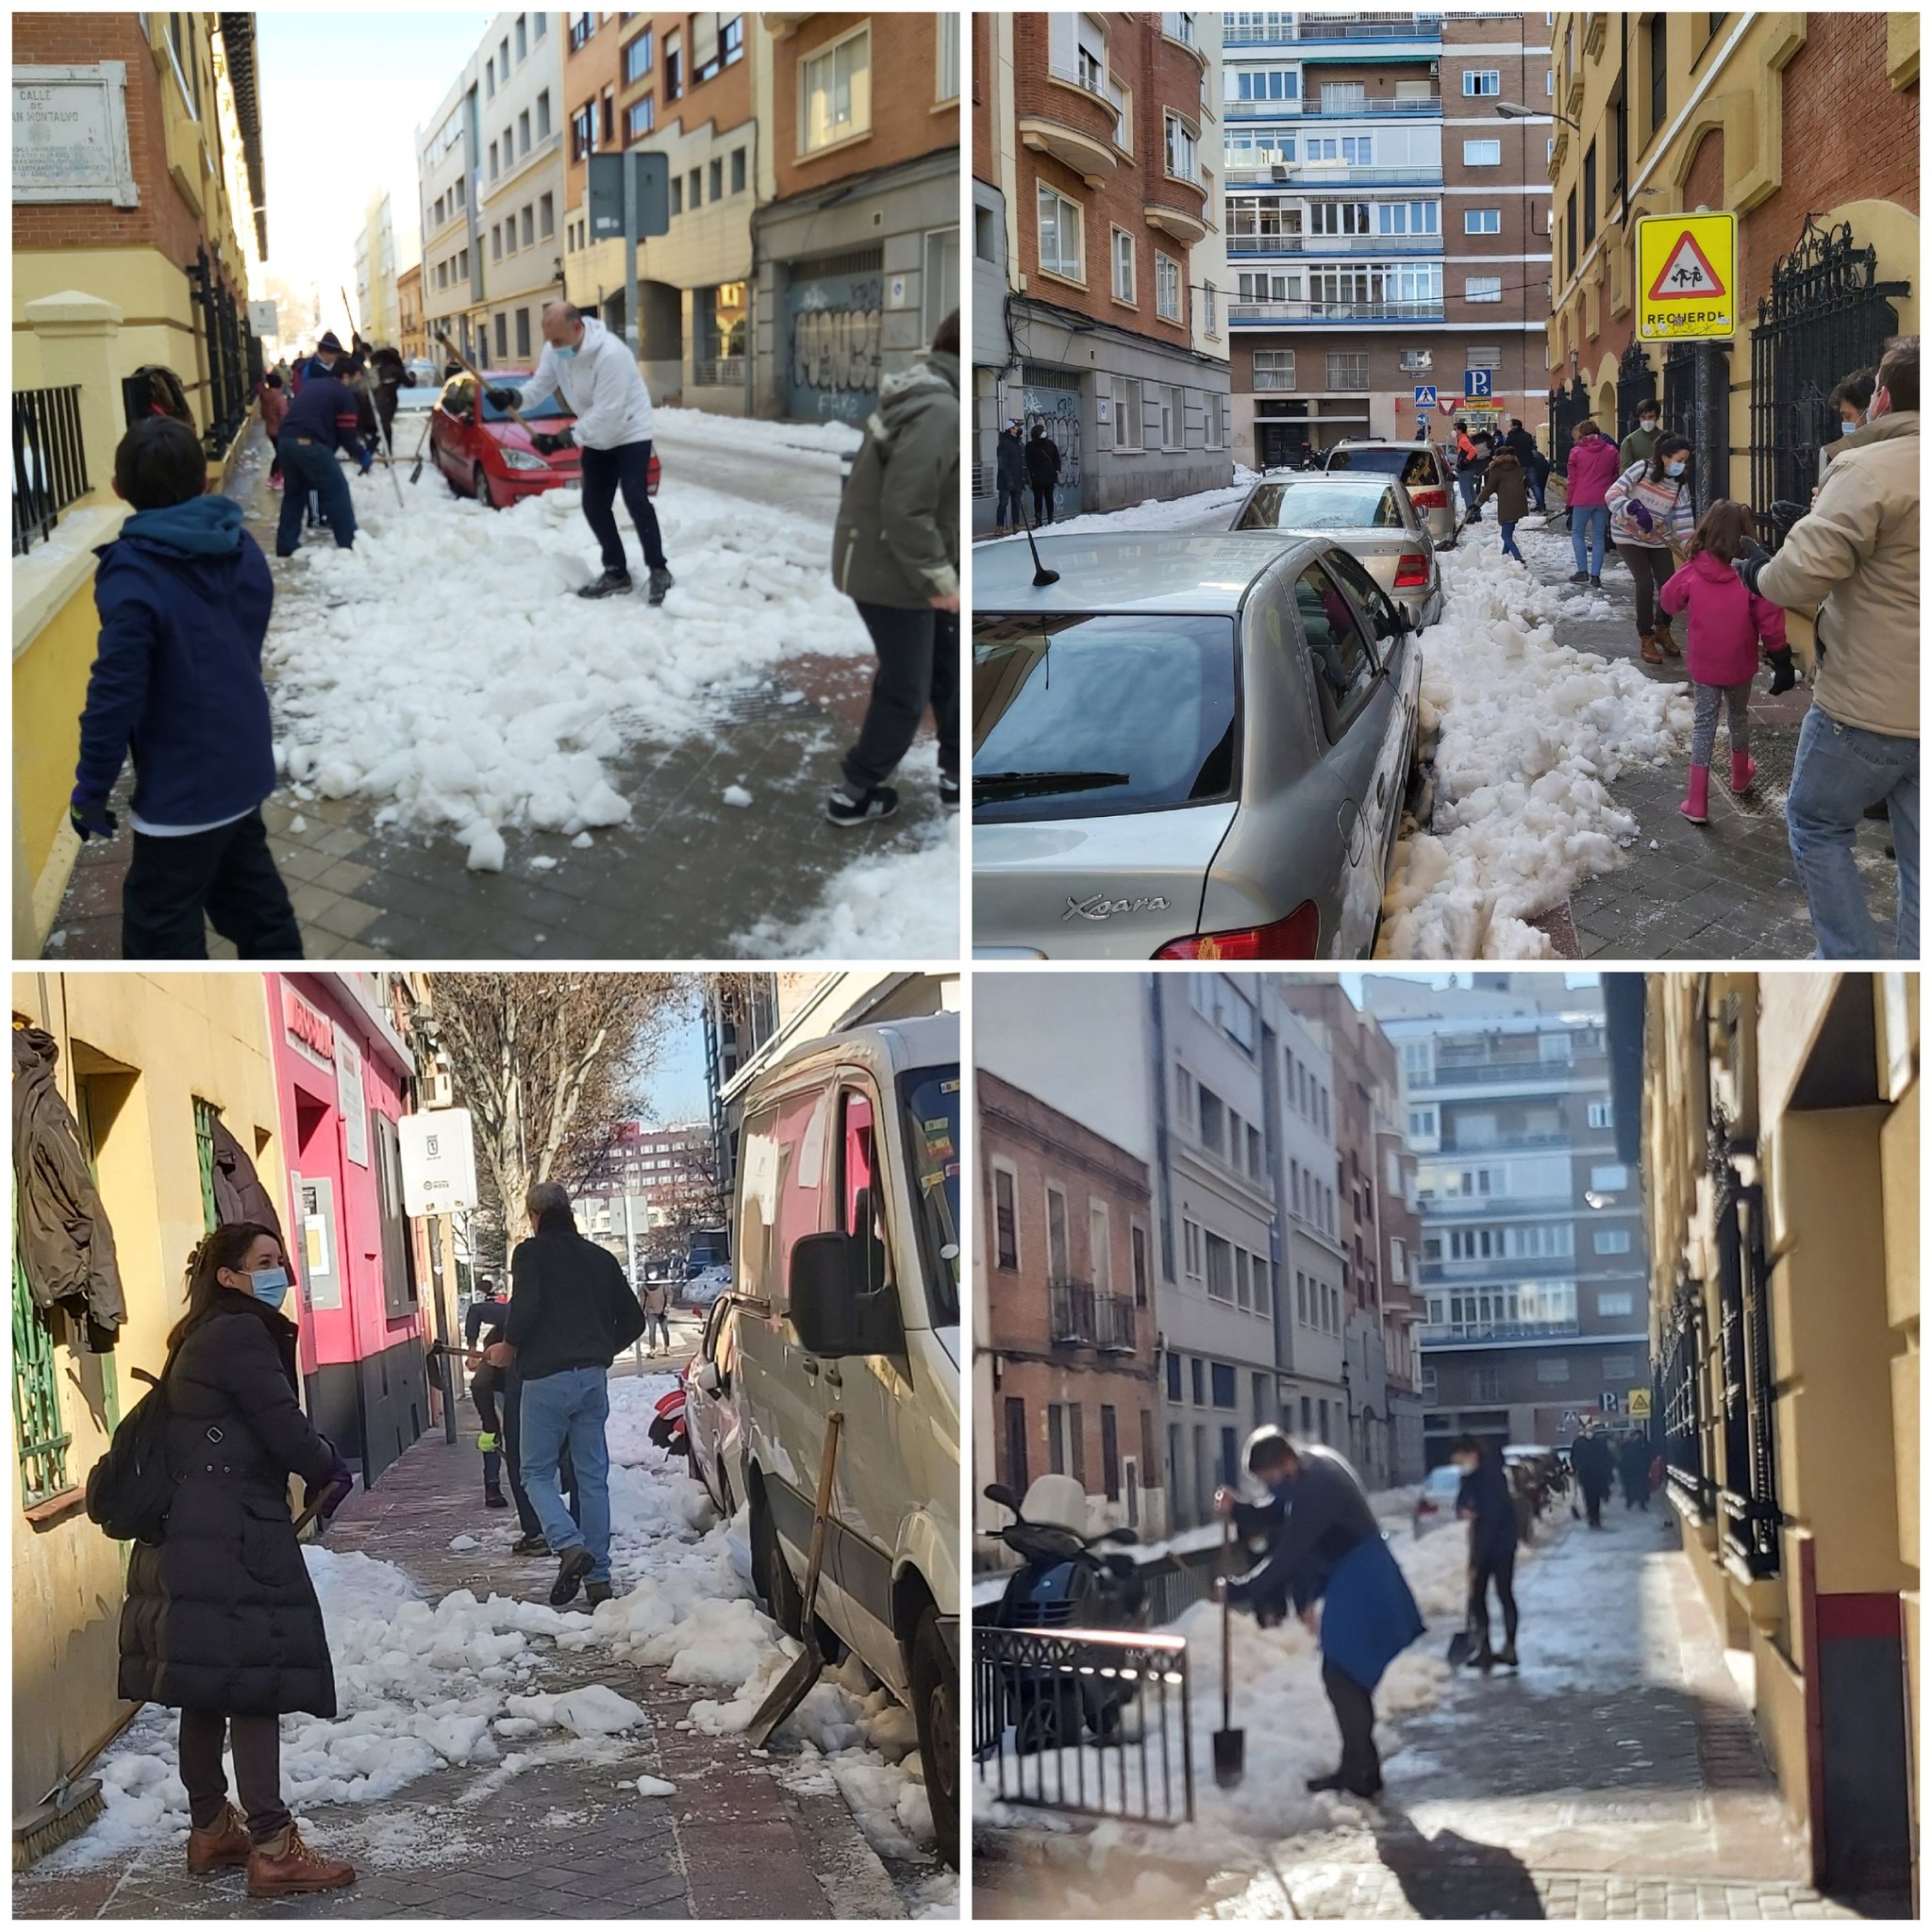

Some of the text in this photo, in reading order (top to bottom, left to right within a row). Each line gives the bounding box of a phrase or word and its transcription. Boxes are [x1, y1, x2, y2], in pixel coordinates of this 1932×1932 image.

[20, 91, 52, 101] CALLE
[26, 111, 78, 123] MONTALVO
[1470, 371, 1487, 396] P
[1062, 893, 1171, 921] Xsara
